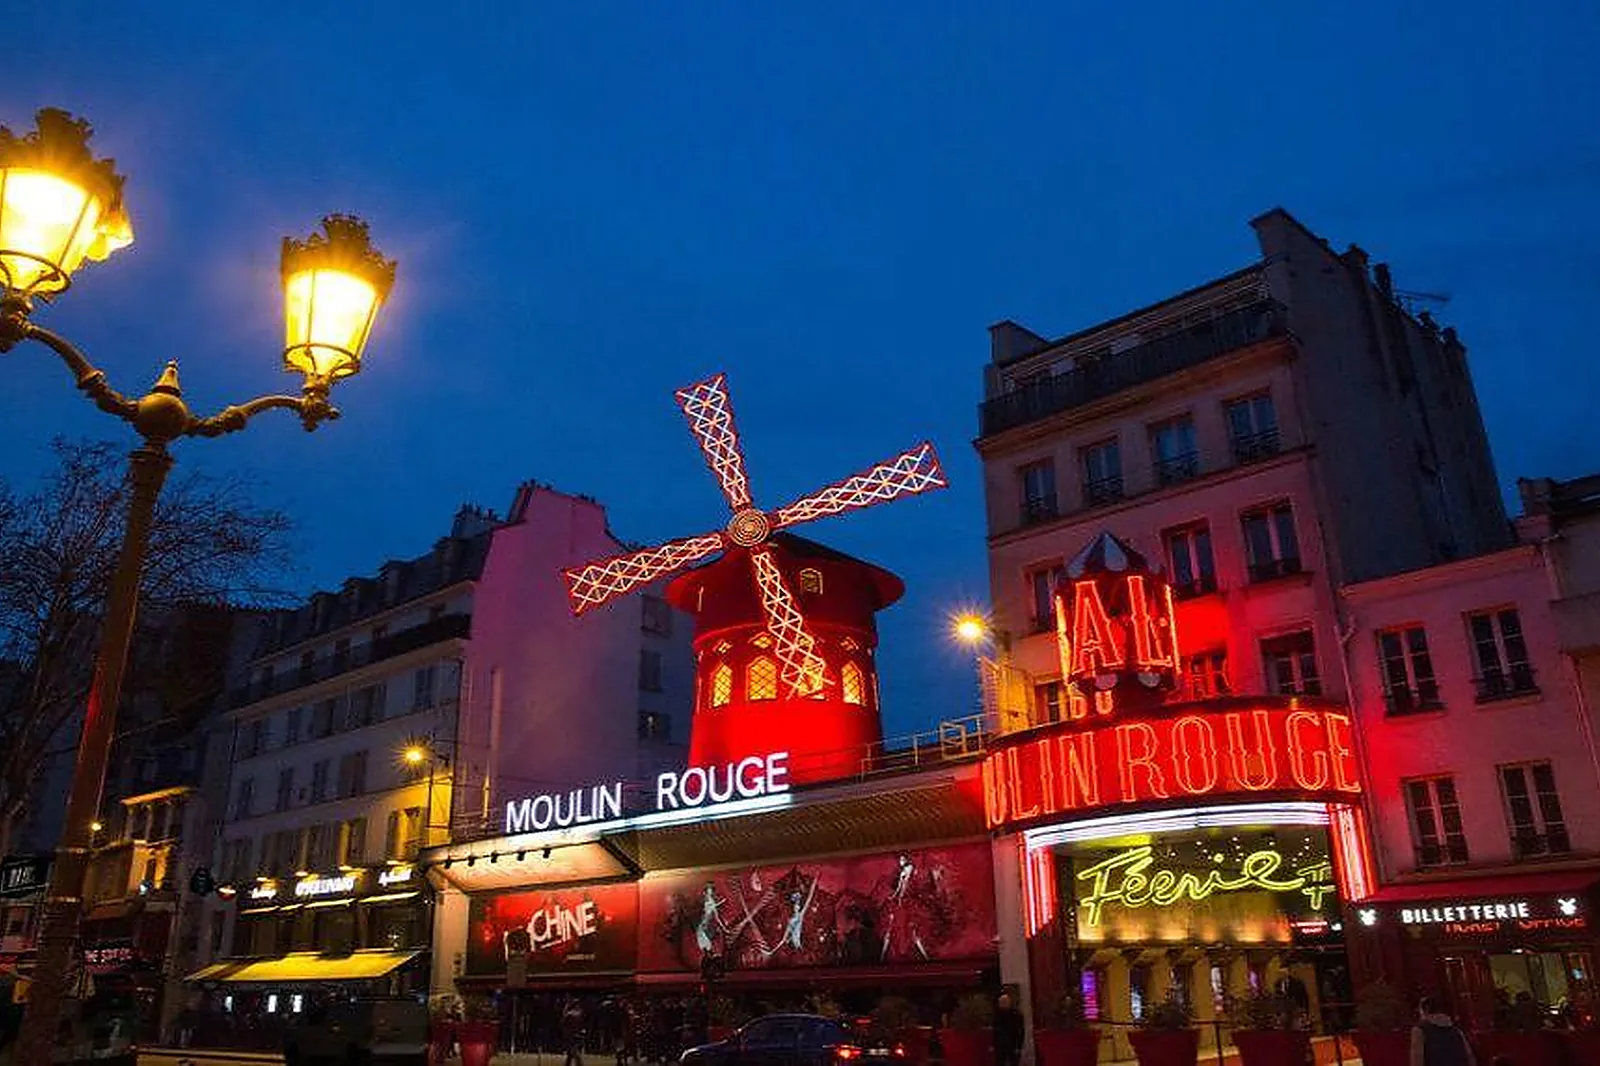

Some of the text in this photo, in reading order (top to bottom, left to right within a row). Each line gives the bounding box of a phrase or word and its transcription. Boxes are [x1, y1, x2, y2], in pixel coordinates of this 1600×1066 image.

[505, 752, 791, 834] MOULIN ROUGE
[1115, 710, 1361, 803] ROUGE
[1401, 902, 1531, 924] BILLETTERIE
